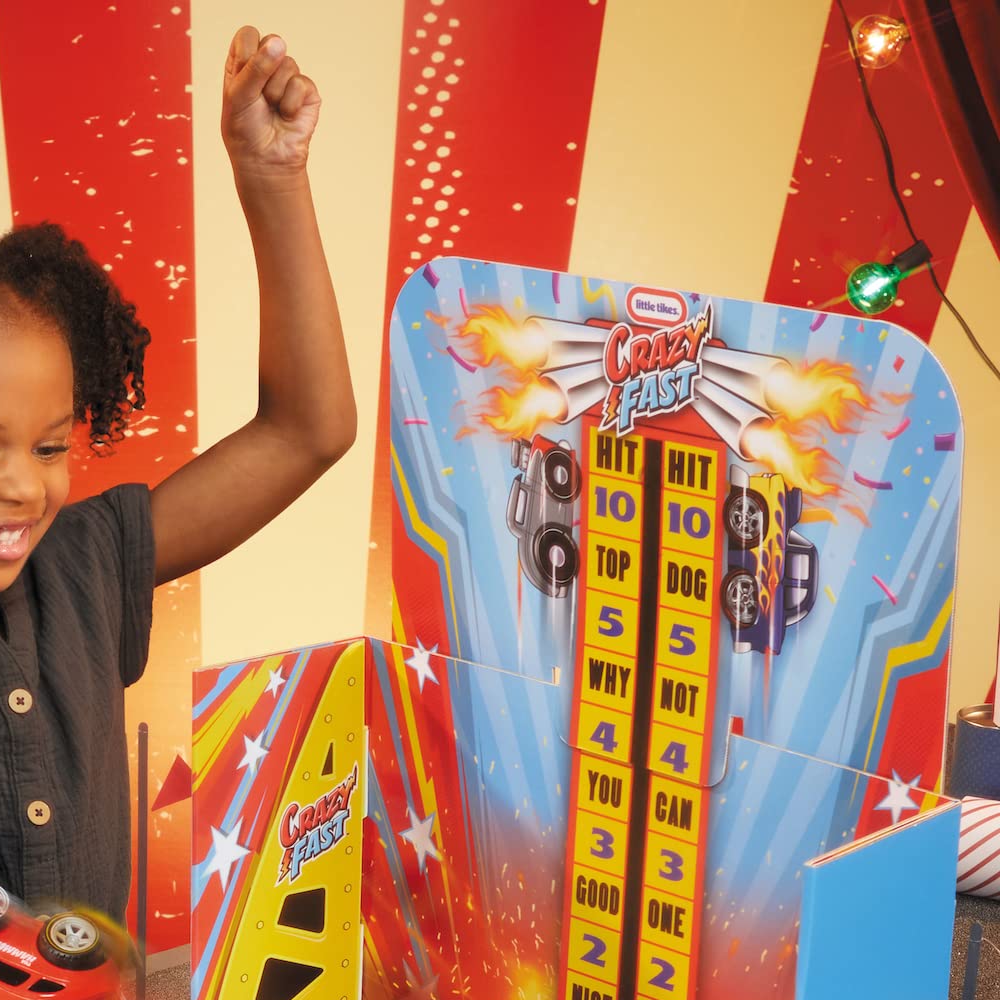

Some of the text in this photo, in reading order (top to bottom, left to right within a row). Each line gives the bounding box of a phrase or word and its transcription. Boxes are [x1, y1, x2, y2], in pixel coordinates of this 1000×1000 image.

[635, 299, 655, 311] little
[605, 306, 713, 384] CRAZY
[621, 366, 699, 432] FAST
[596, 435, 638, 475] HIT
[668, 449, 712, 490] HIT
[595, 487, 636, 522] 10
[668, 502, 710, 540] 10
[595, 545, 631, 582] TOP
[667, 561, 707, 602] DOG
[598, 606, 624, 638] 5
[669, 624, 696, 656] 5
[588, 658, 631, 700] WHY
[661, 678, 698, 718] NOT
[590, 721, 618, 754] 4
[660, 741, 688, 773] 4
[280, 765, 357, 848] CRAZY
[587, 770, 622, 809] YOU
[656, 791, 692, 831] CAN
[291, 809, 350, 882] FAST
[590, 827, 615, 860] 3
[658, 849, 684, 882] 3
[577, 875, 620, 916] GOOD
[648, 898, 684, 939] ONE
[580, 933, 607, 968] 2
[647, 956, 675, 991] 2
